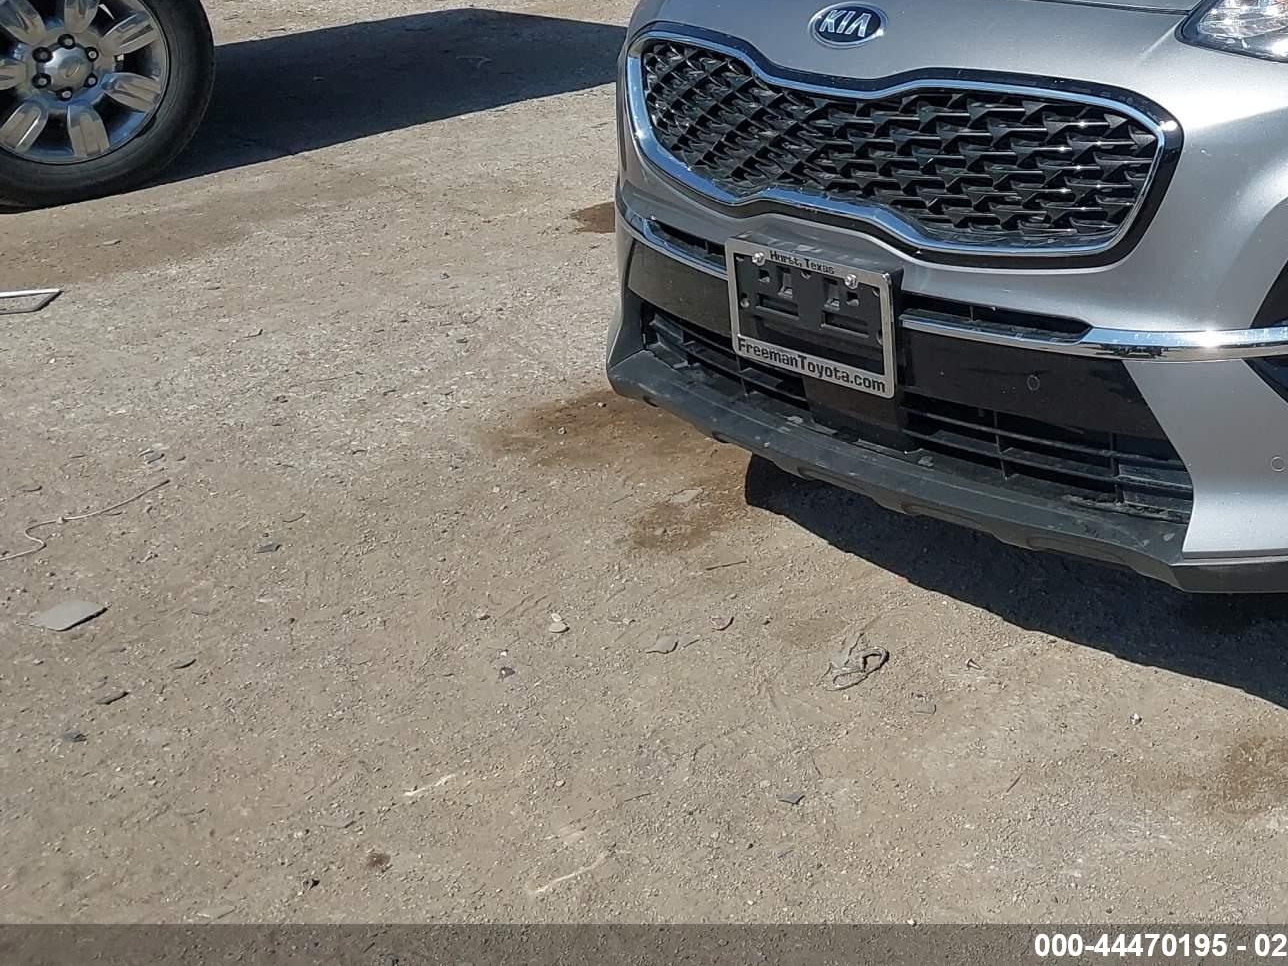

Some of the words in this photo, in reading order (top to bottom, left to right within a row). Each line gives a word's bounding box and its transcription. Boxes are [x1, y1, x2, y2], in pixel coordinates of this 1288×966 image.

[819, 9, 872, 38] KIA
[803, 258, 835, 275] Texas
[737, 336, 886, 393] FreemanToyota.com
